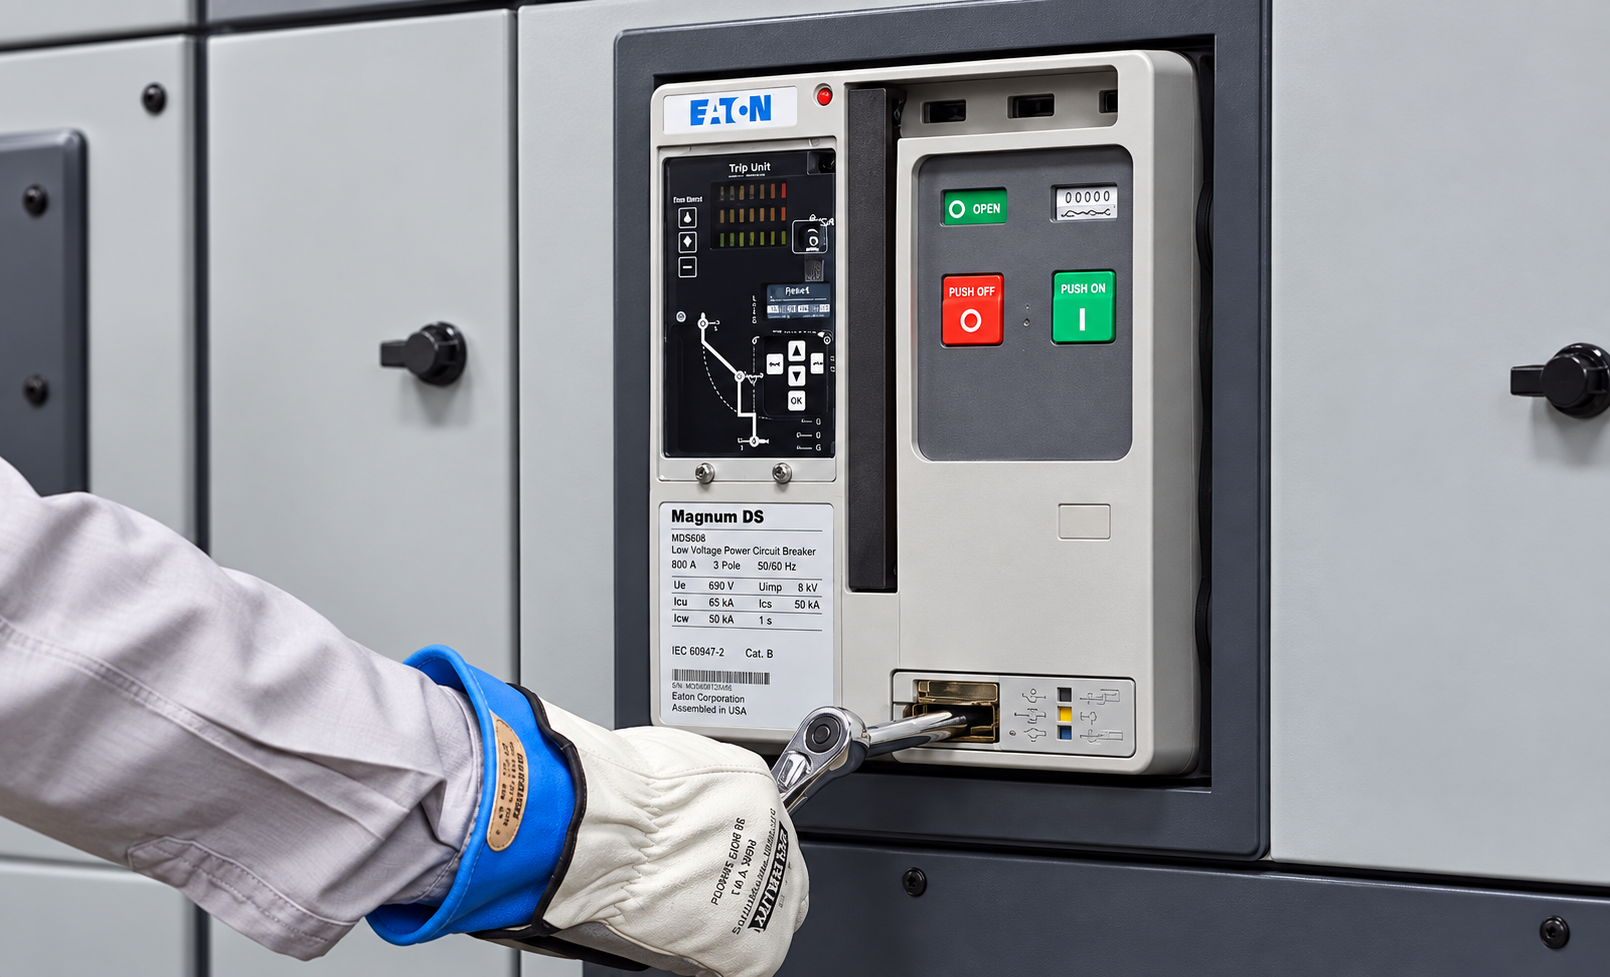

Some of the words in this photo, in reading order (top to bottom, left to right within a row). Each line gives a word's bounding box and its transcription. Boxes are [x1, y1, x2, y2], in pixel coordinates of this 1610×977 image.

[690, 94, 771, 126] EATON
[729, 164, 748, 174] Trip
[751, 162, 770, 171] Unit
[973, 203, 1000, 214] OPEN
[949, 287, 974, 297] PUSH
[977, 287, 995, 296] OFF
[1061, 284, 1087, 294] PUSH
[1091, 283, 1105, 293] ON
[671, 509, 737, 526] Magnum
[743, 510, 764, 523] DS
[672, 534, 705, 542] MDS608
[672, 546, 688, 554] Low
[691, 546, 722, 557] Voltage
[724, 546, 750, 555] Power
[753, 546, 780, 555] Circuit
[783, 547, 816, 556] Breaker
[672, 560, 687, 569] 800
[690, 561, 696, 569] A
[714, 561, 719, 569] 3
[722, 561, 740, 570] Pole
[758, 561, 782, 571] 50/60
[785, 562, 796, 571] Hz
[674, 581, 685, 589] Ue
[709, 581, 725, 590] 690
[726, 582, 734, 590] V
[759, 583, 782, 594] Uimp
[798, 583, 803, 592] 8
[806, 583, 817, 592] kV
[674, 597, 687, 606] Icu
[709, 598, 720, 607] 65
[722, 598, 734, 607] kA
[759, 599, 772, 608] Ics
[795, 600, 805, 609] 50
[808, 600, 820, 609] kA
[674, 614, 689, 622] Icw
[709, 614, 720, 623] 50
[722, 615, 734, 624] kA
[760, 616, 763, 624] 1
[672, 646, 687, 655] IEC
[690, 647, 724, 657] 60947-2
[746, 648, 763, 658] Cat.
[767, 649, 773, 658] B
[672, 692, 695, 700] Eaton
[697, 693, 744, 703] Corporation
[672, 704, 716, 713] Assembled
[719, 706, 726, 714] in
[729, 706, 747, 715] USA
